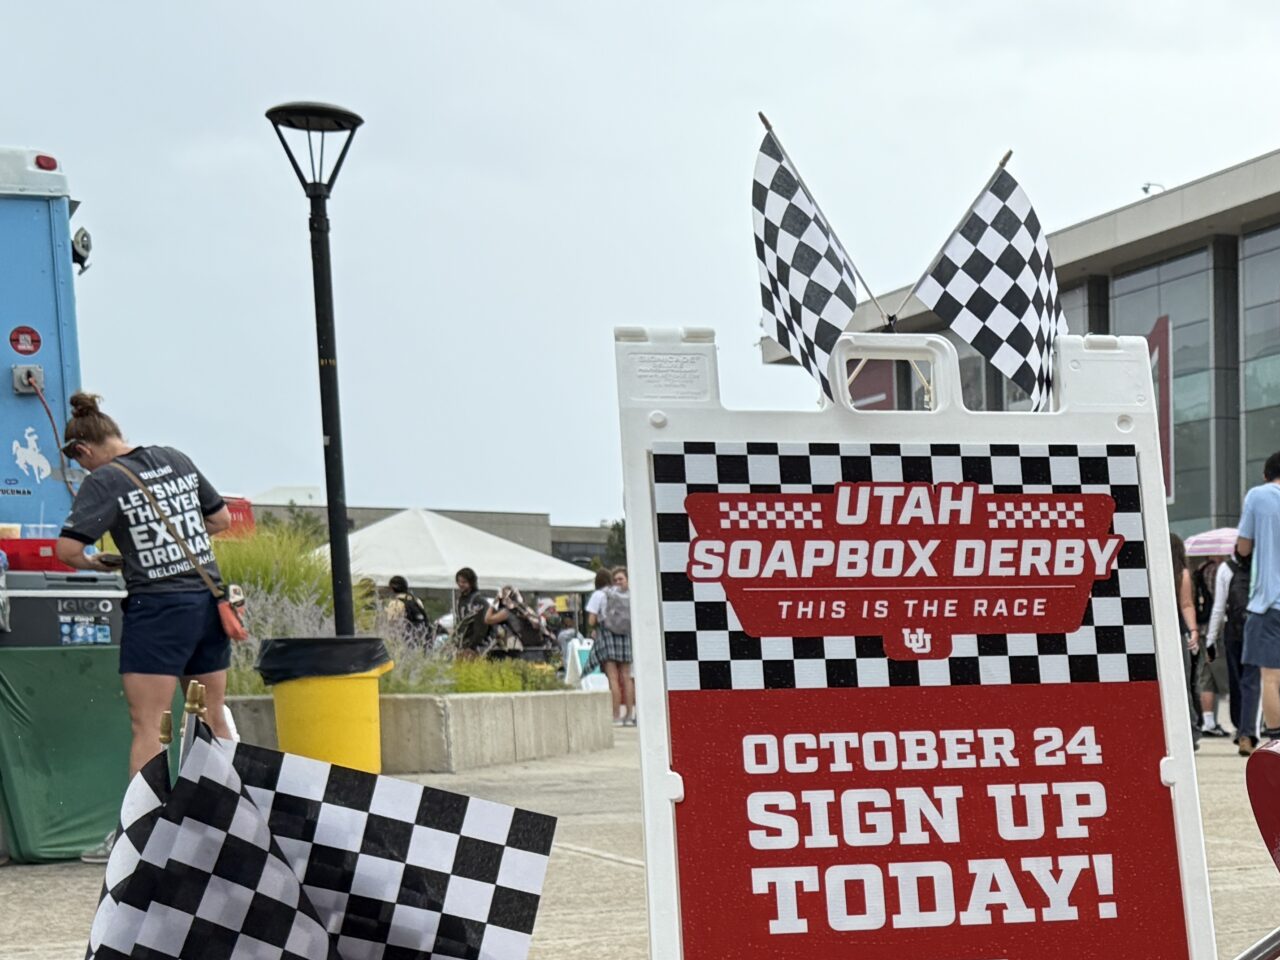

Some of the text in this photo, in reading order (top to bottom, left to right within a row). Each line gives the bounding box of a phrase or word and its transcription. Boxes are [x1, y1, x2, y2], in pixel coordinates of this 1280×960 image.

[123, 488, 201, 525] THIS YEA
[163, 473, 200, 497] MAKE
[835, 483, 975, 526] UTAH
[128, 510, 206, 551] EXTR
[690, 534, 1122, 579] SOAPBOX DERBY
[778, 598, 1047, 620] THIS IS THE RACE
[742, 725, 1103, 775] OCTOBER 24
[746, 780, 1108, 850] SIGN UP
[751, 853, 1118, 935] TODAY!
